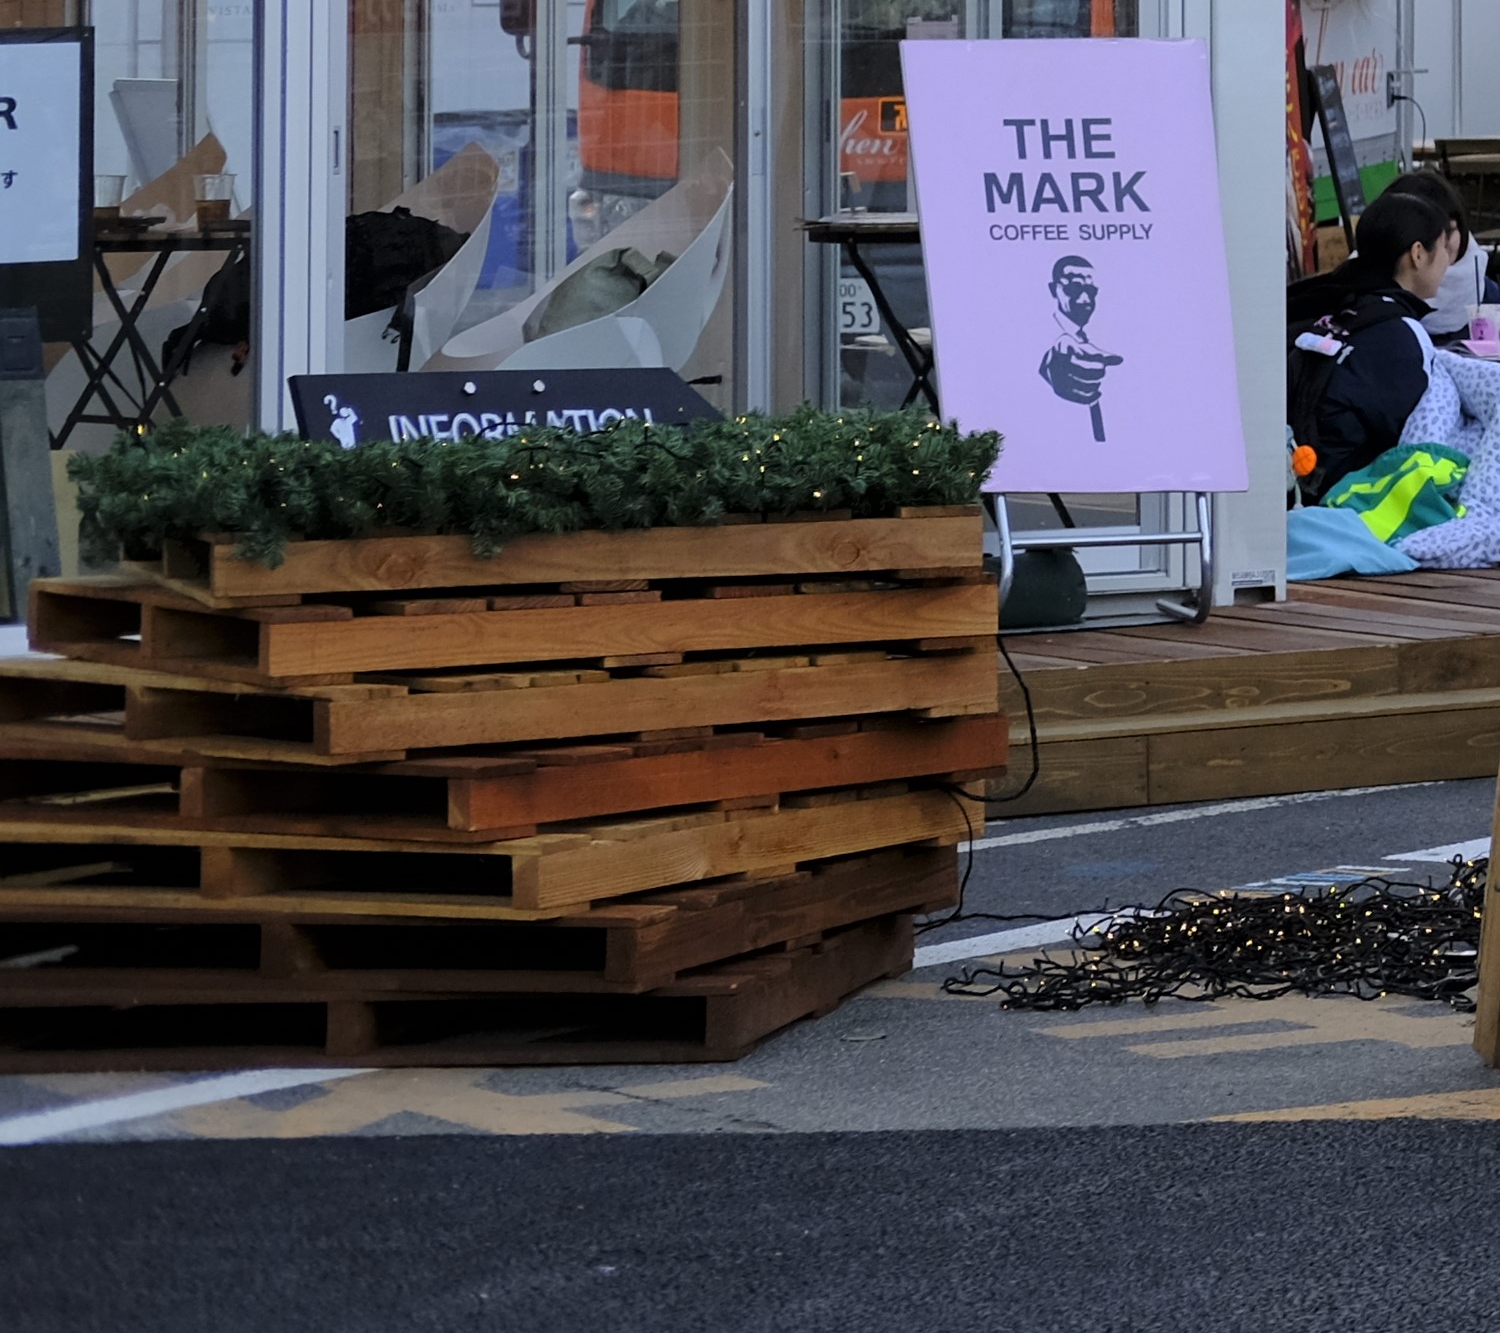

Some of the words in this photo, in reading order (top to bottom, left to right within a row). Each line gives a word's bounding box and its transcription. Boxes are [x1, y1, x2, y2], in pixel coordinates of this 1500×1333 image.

[1003, 117, 1116, 160] THE
[983, 171, 1152, 214] MARK
[989, 223, 1070, 242] COFFEE
[1079, 223, 1154, 241] SUPPLY
